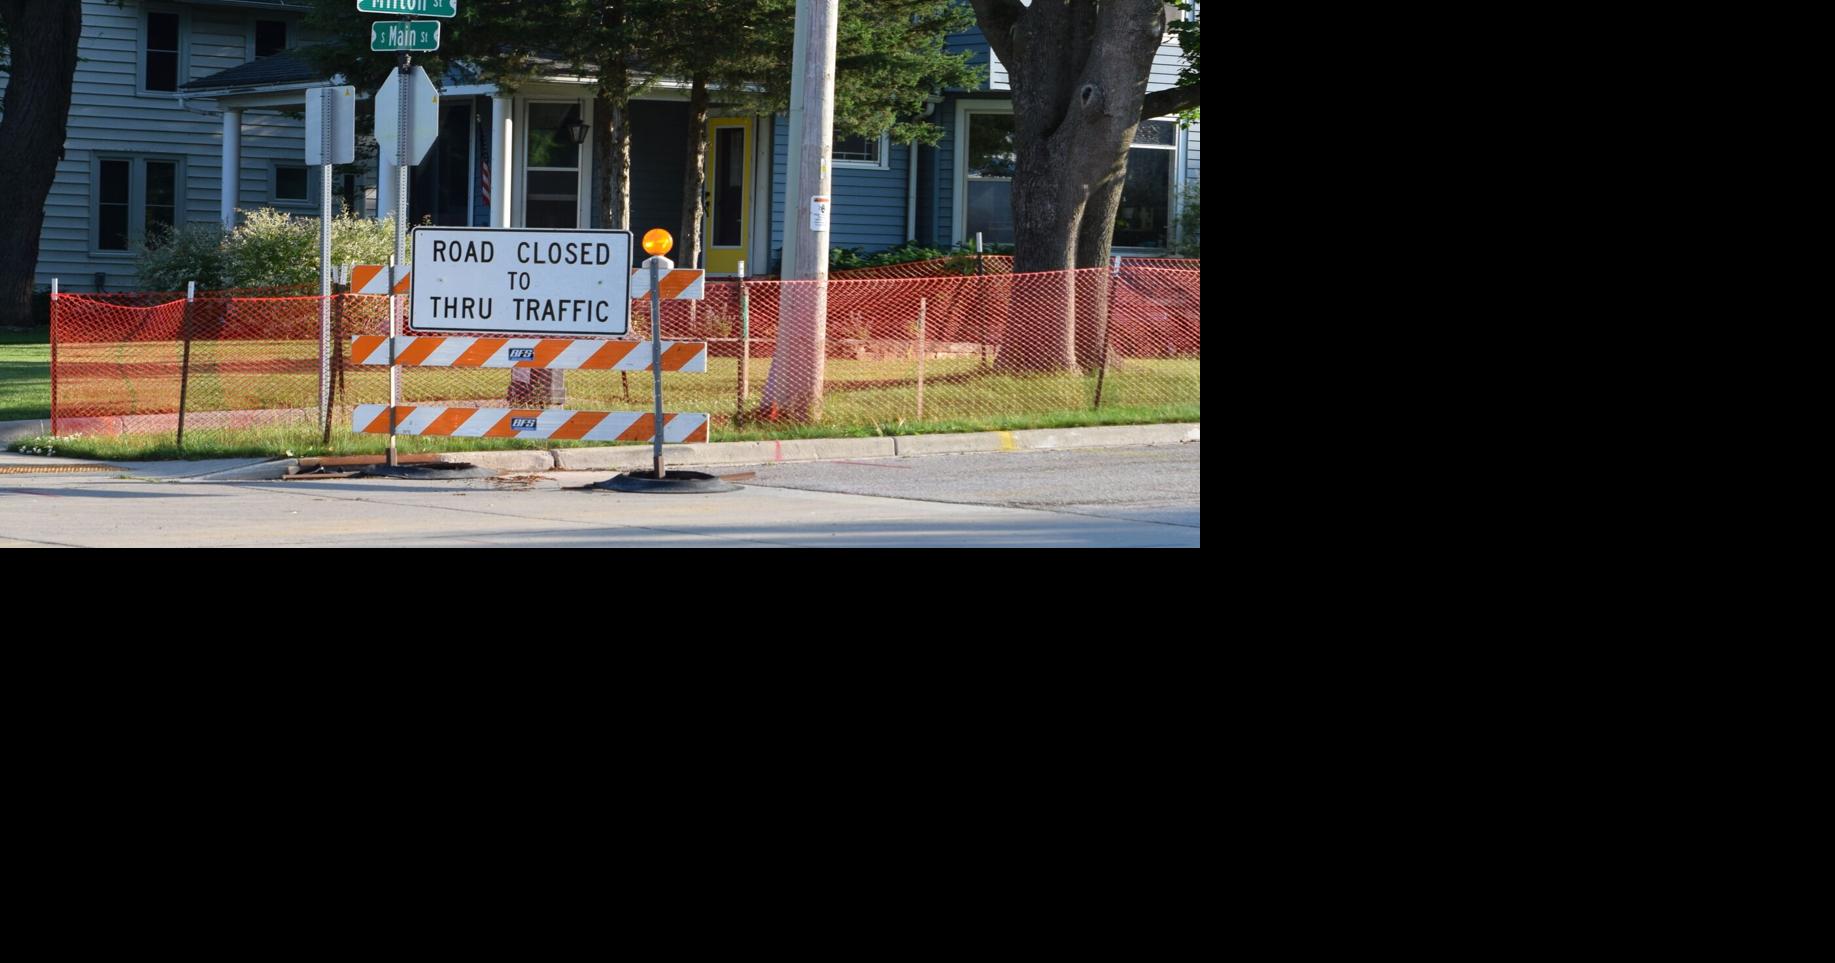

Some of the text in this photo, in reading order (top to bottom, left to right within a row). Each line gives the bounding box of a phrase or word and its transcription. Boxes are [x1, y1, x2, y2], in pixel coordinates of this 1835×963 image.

[381, 25, 428, 46] S Main St
[433, 240, 610, 265] ROAD CLOSED
[507, 271, 531, 290] TO
[430, 296, 609, 323] THRU TRAFFIC
